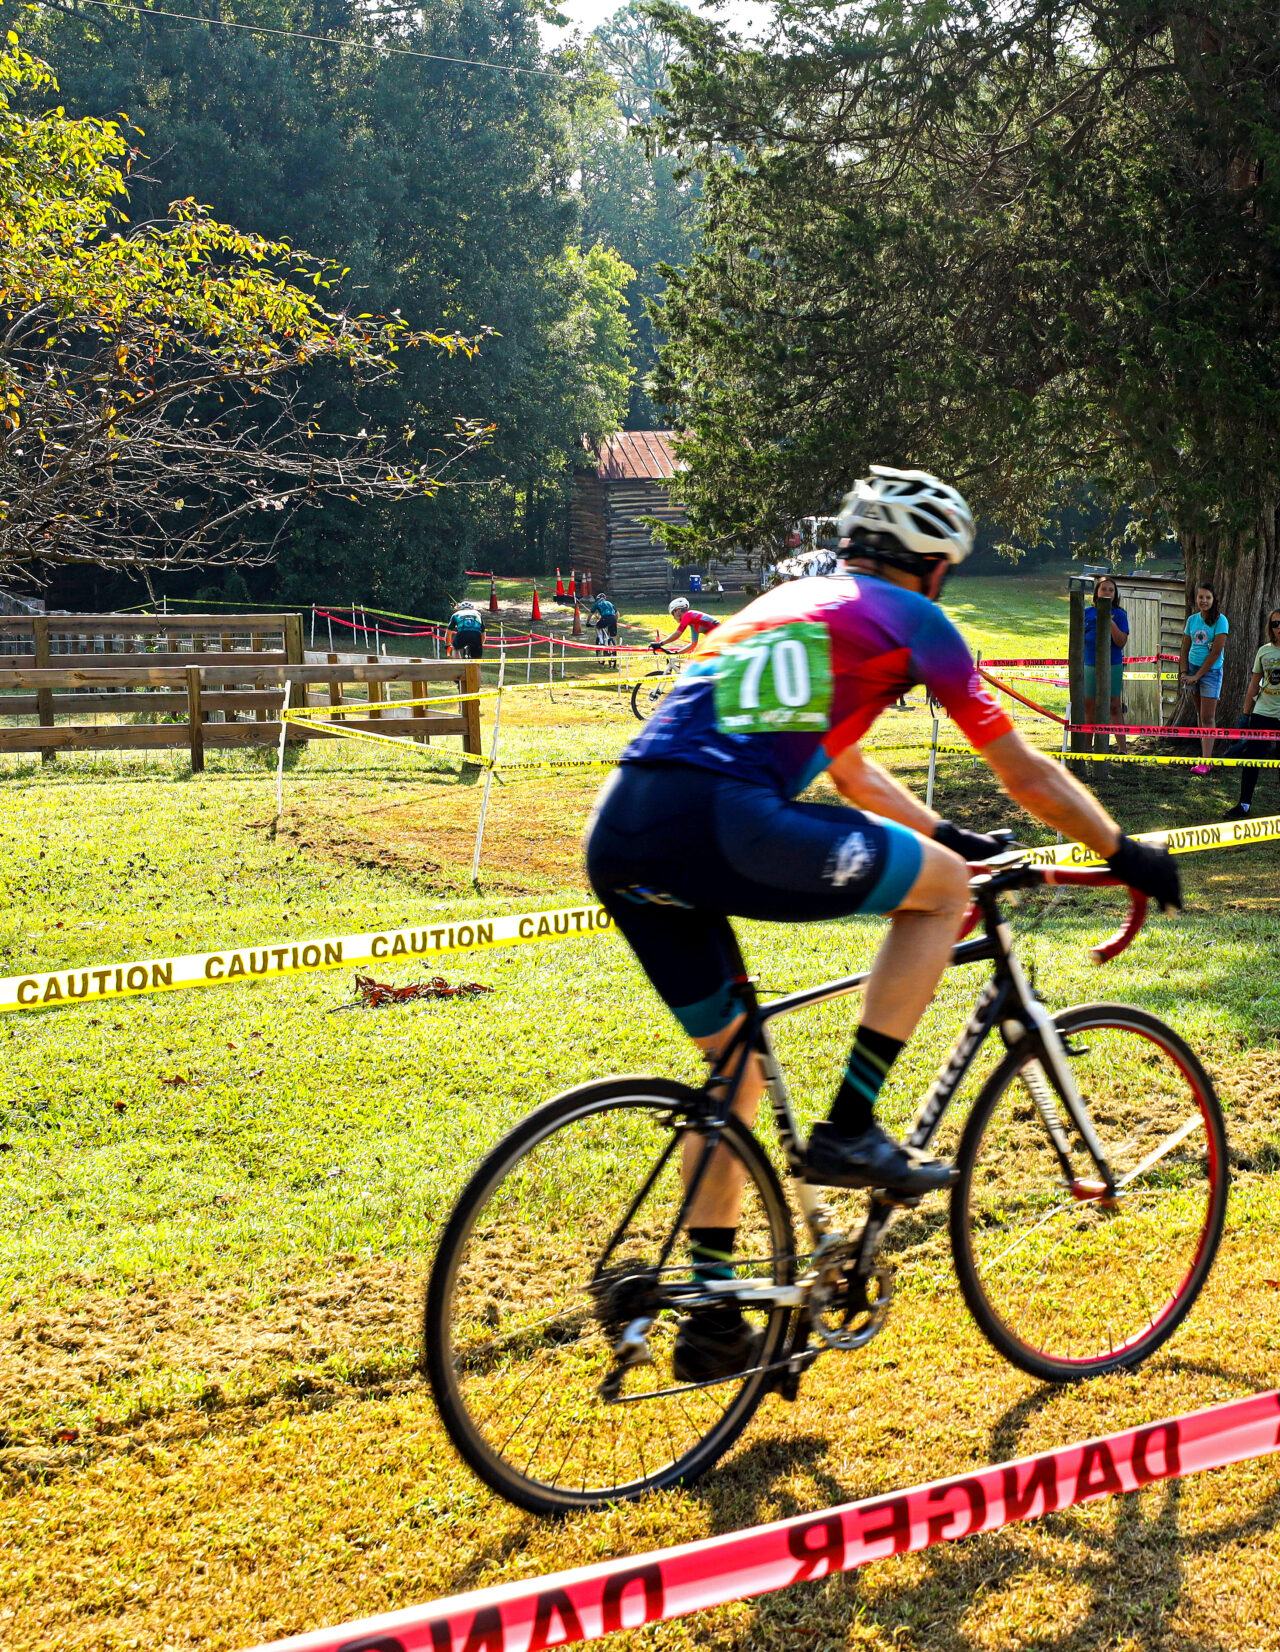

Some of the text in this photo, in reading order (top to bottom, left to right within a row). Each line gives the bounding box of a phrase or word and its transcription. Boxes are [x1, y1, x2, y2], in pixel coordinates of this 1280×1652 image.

[734, 640, 811, 709] 70
[1189, 729, 1230, 738] DANGER
[1167, 827, 1222, 849] AUTION
[17, 907, 613, 1006] CAUTION CAUTION CAUTION CAUTIO
